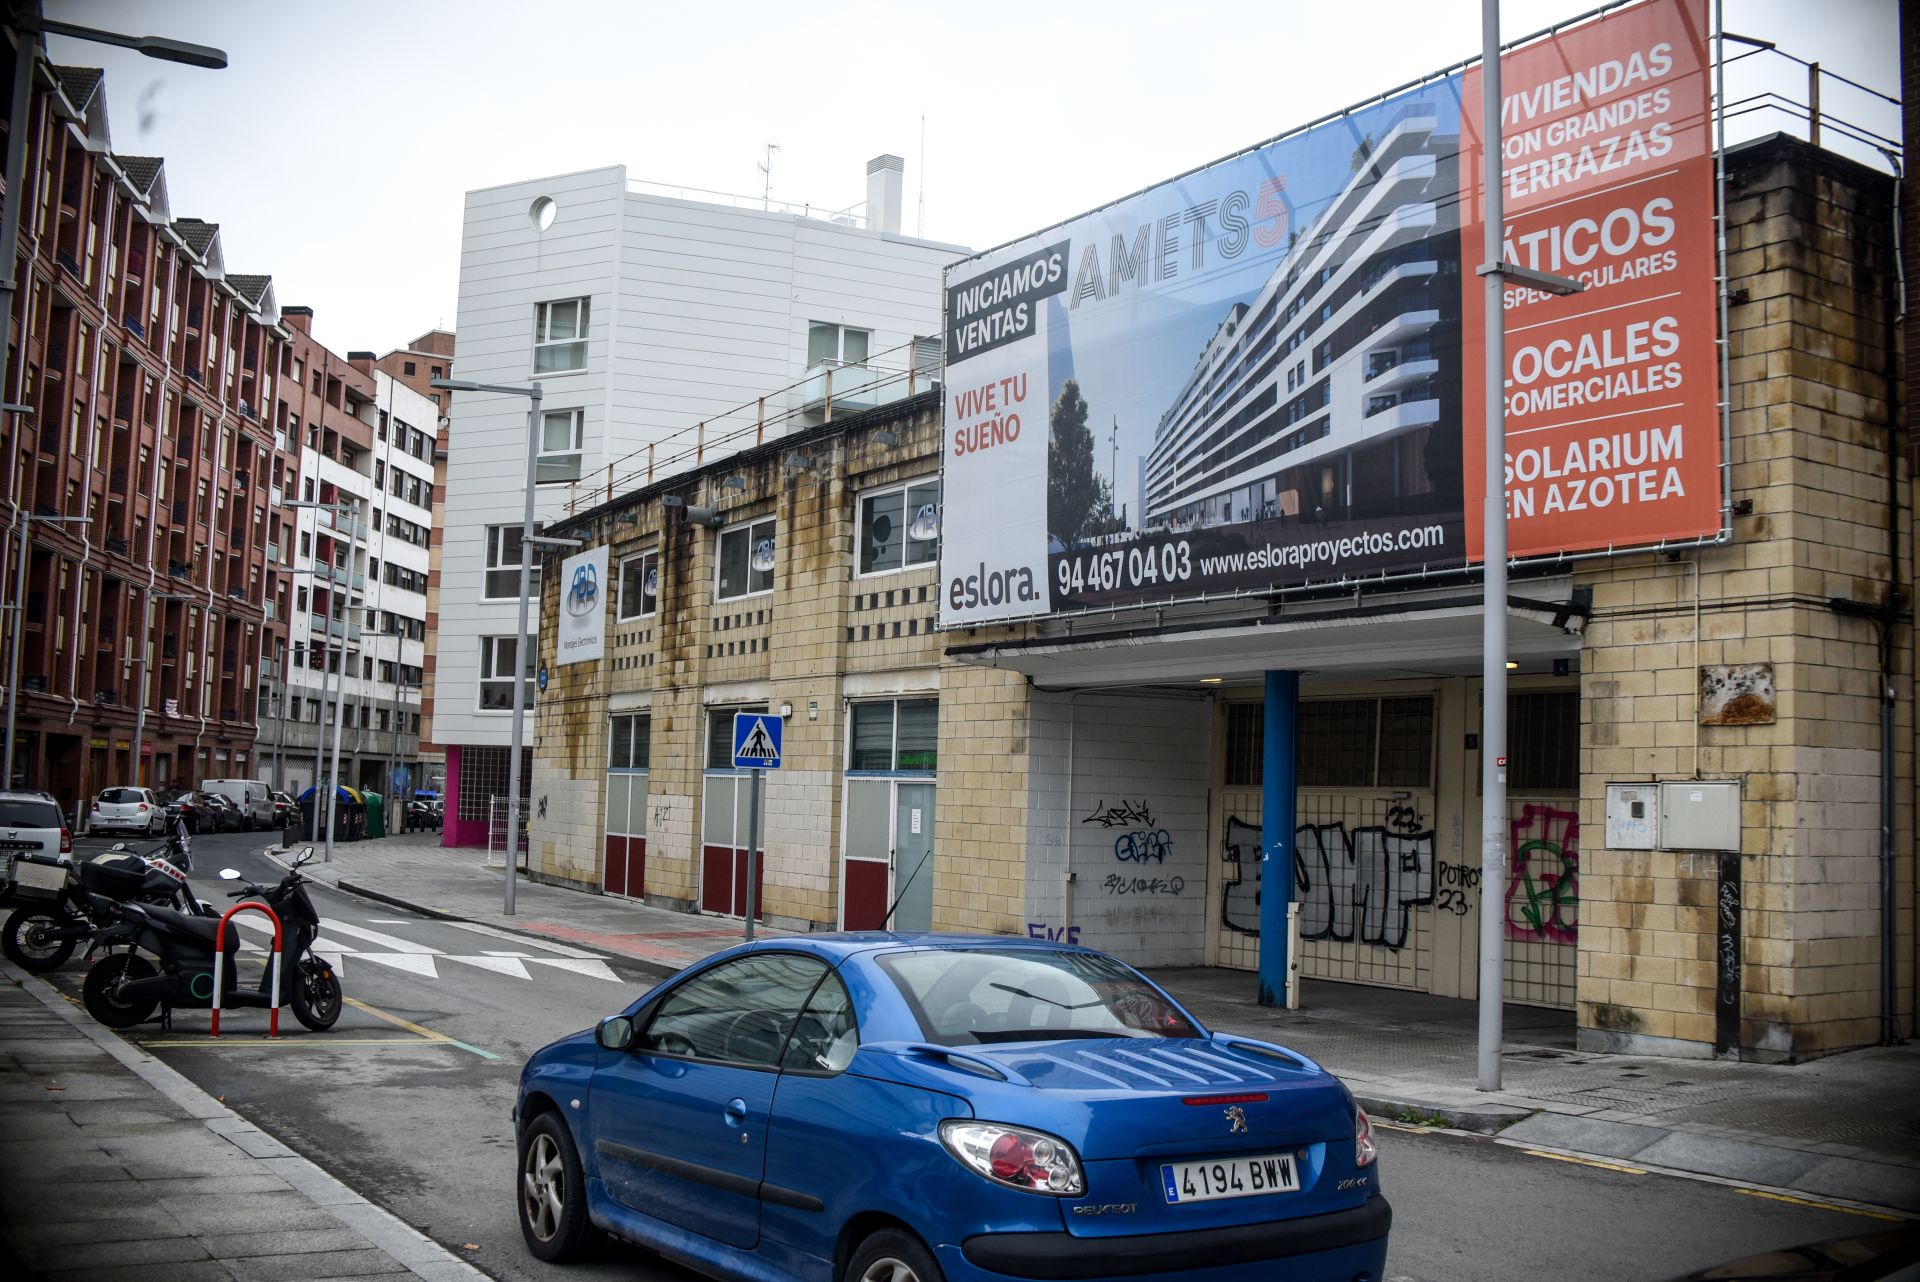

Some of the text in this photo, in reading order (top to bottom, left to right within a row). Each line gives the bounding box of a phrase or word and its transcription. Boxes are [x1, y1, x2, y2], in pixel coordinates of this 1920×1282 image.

[1502, 88, 1671, 161] ON GRANDES
[956, 254, 1062, 320] INICIAMOS
[1504, 250, 1678, 310] SPECULARES
[955, 302, 1029, 353] VENTAS
[955, 372, 1027, 420] VIVE TU
[1505, 362, 1683, 418] OMERCIALES
[954, 412, 1021, 456] SUEÑO
[1506, 467, 1686, 519] N AZOTEA
[1200, 524, 1444, 576] www.esloraproyectos.com
[1182, 1161, 1244, 1196] 4194
[1249, 1158, 1293, 1190] BWW
[1073, 1203, 1138, 1216] PEUGEOT
